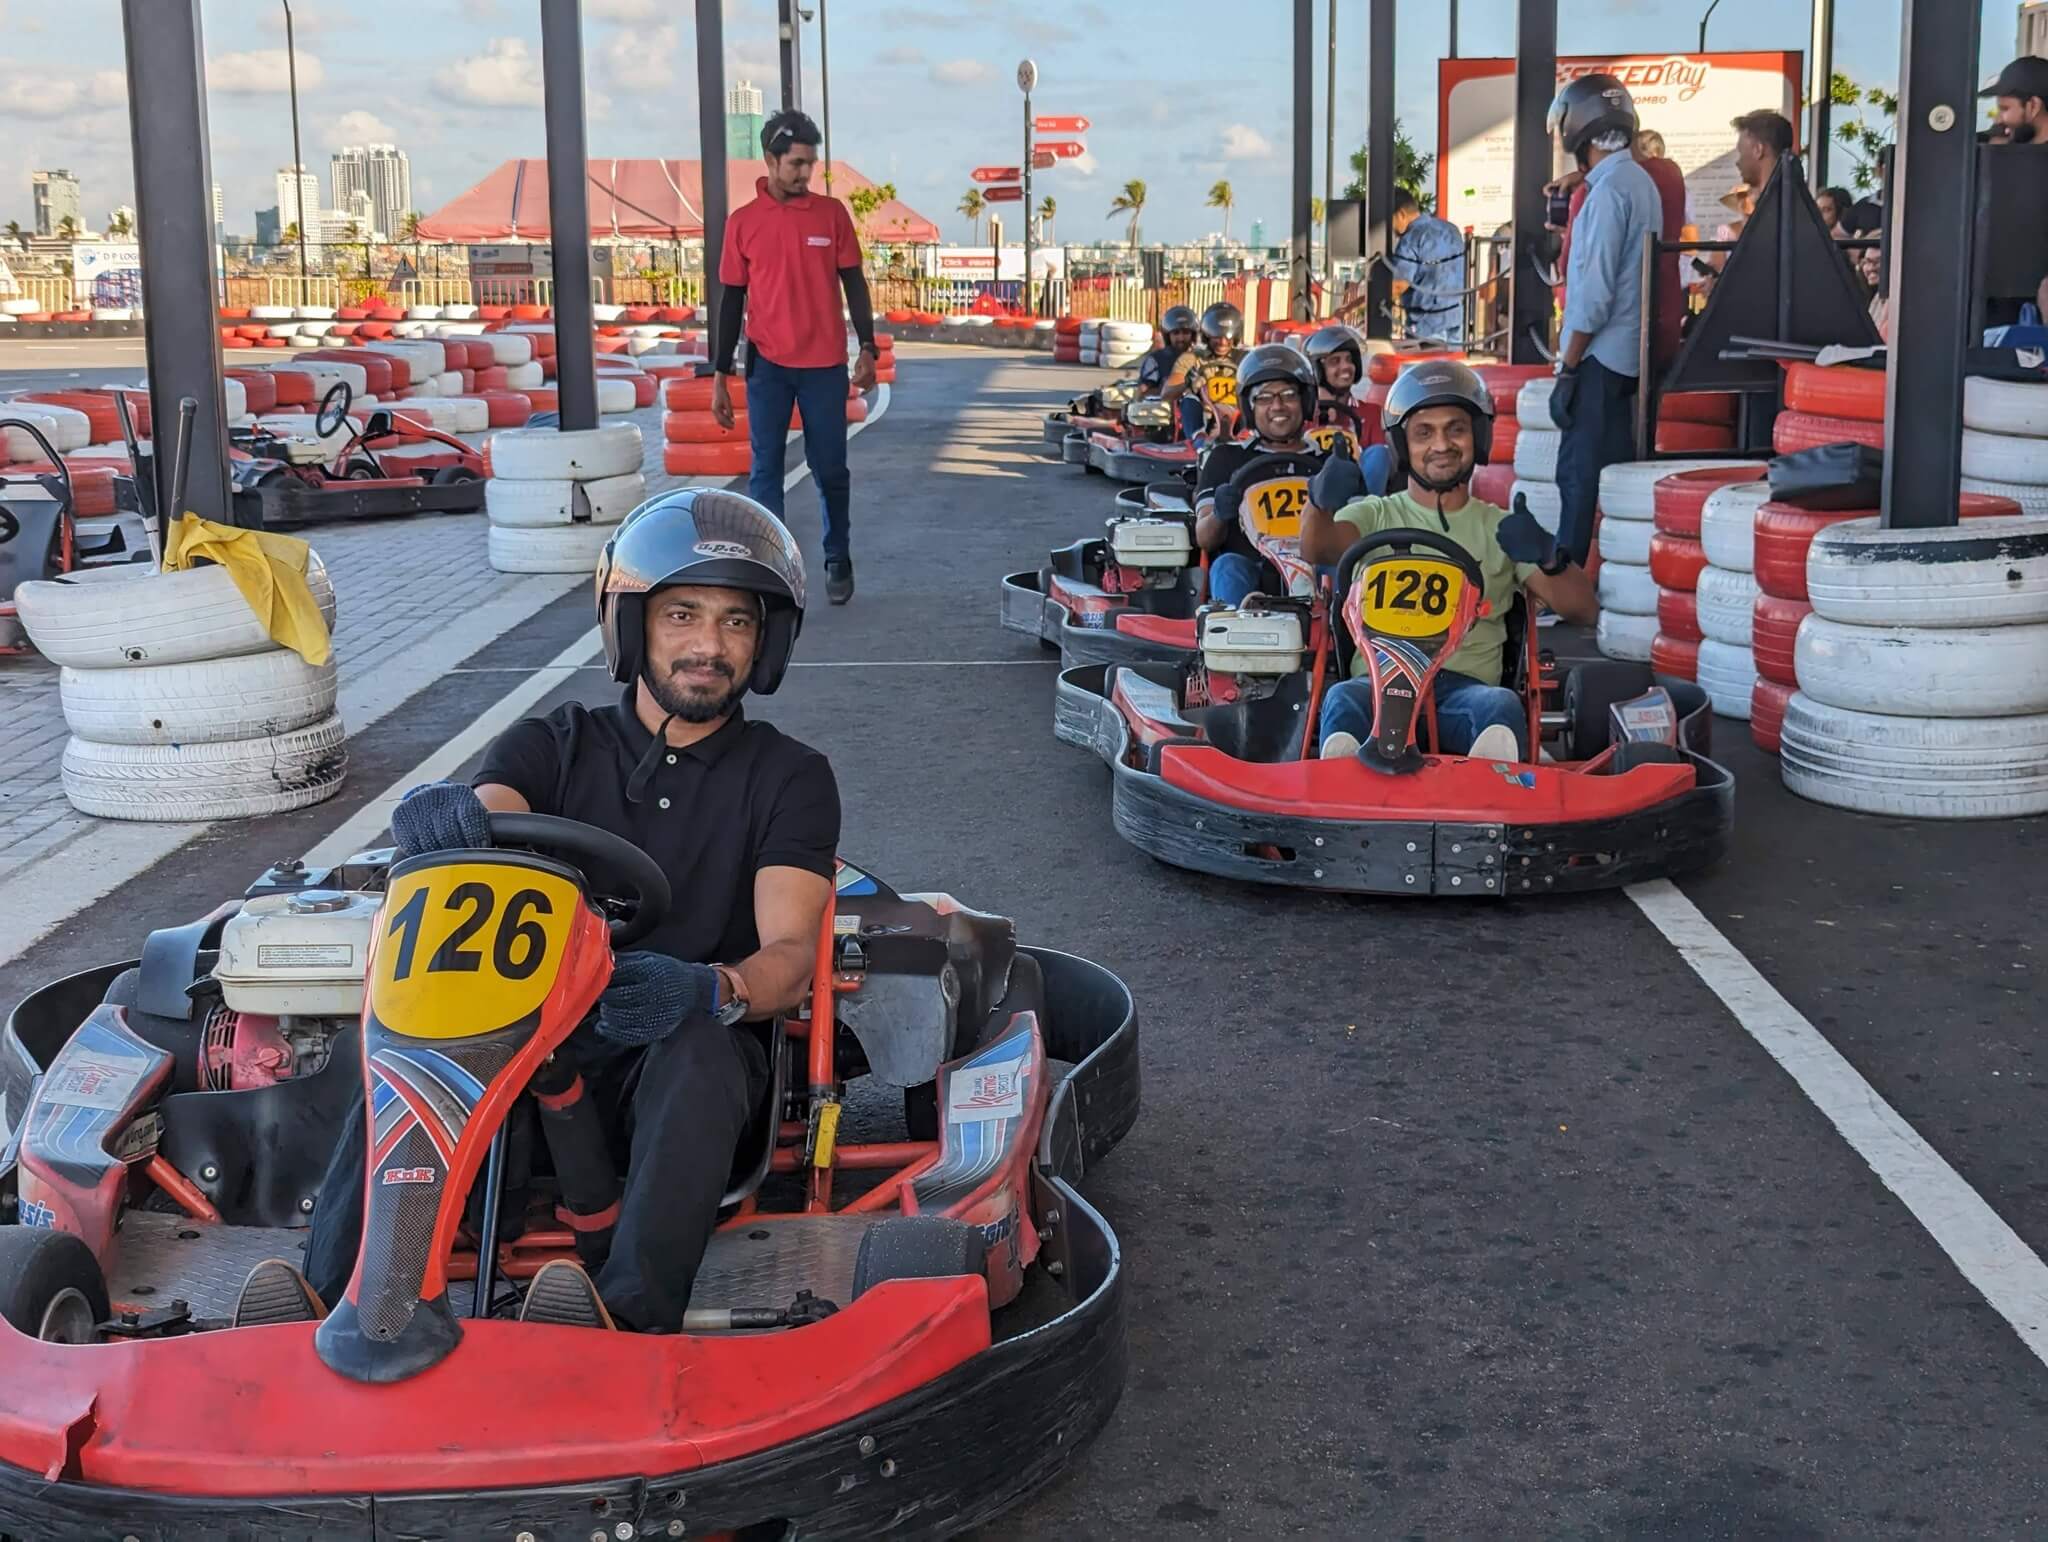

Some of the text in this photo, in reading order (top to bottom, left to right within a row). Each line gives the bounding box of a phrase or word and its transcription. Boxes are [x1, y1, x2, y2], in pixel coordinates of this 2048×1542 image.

[1257, 488, 1308, 520] 125
[1367, 569, 1450, 616] 128
[387, 881, 553, 982] 126
